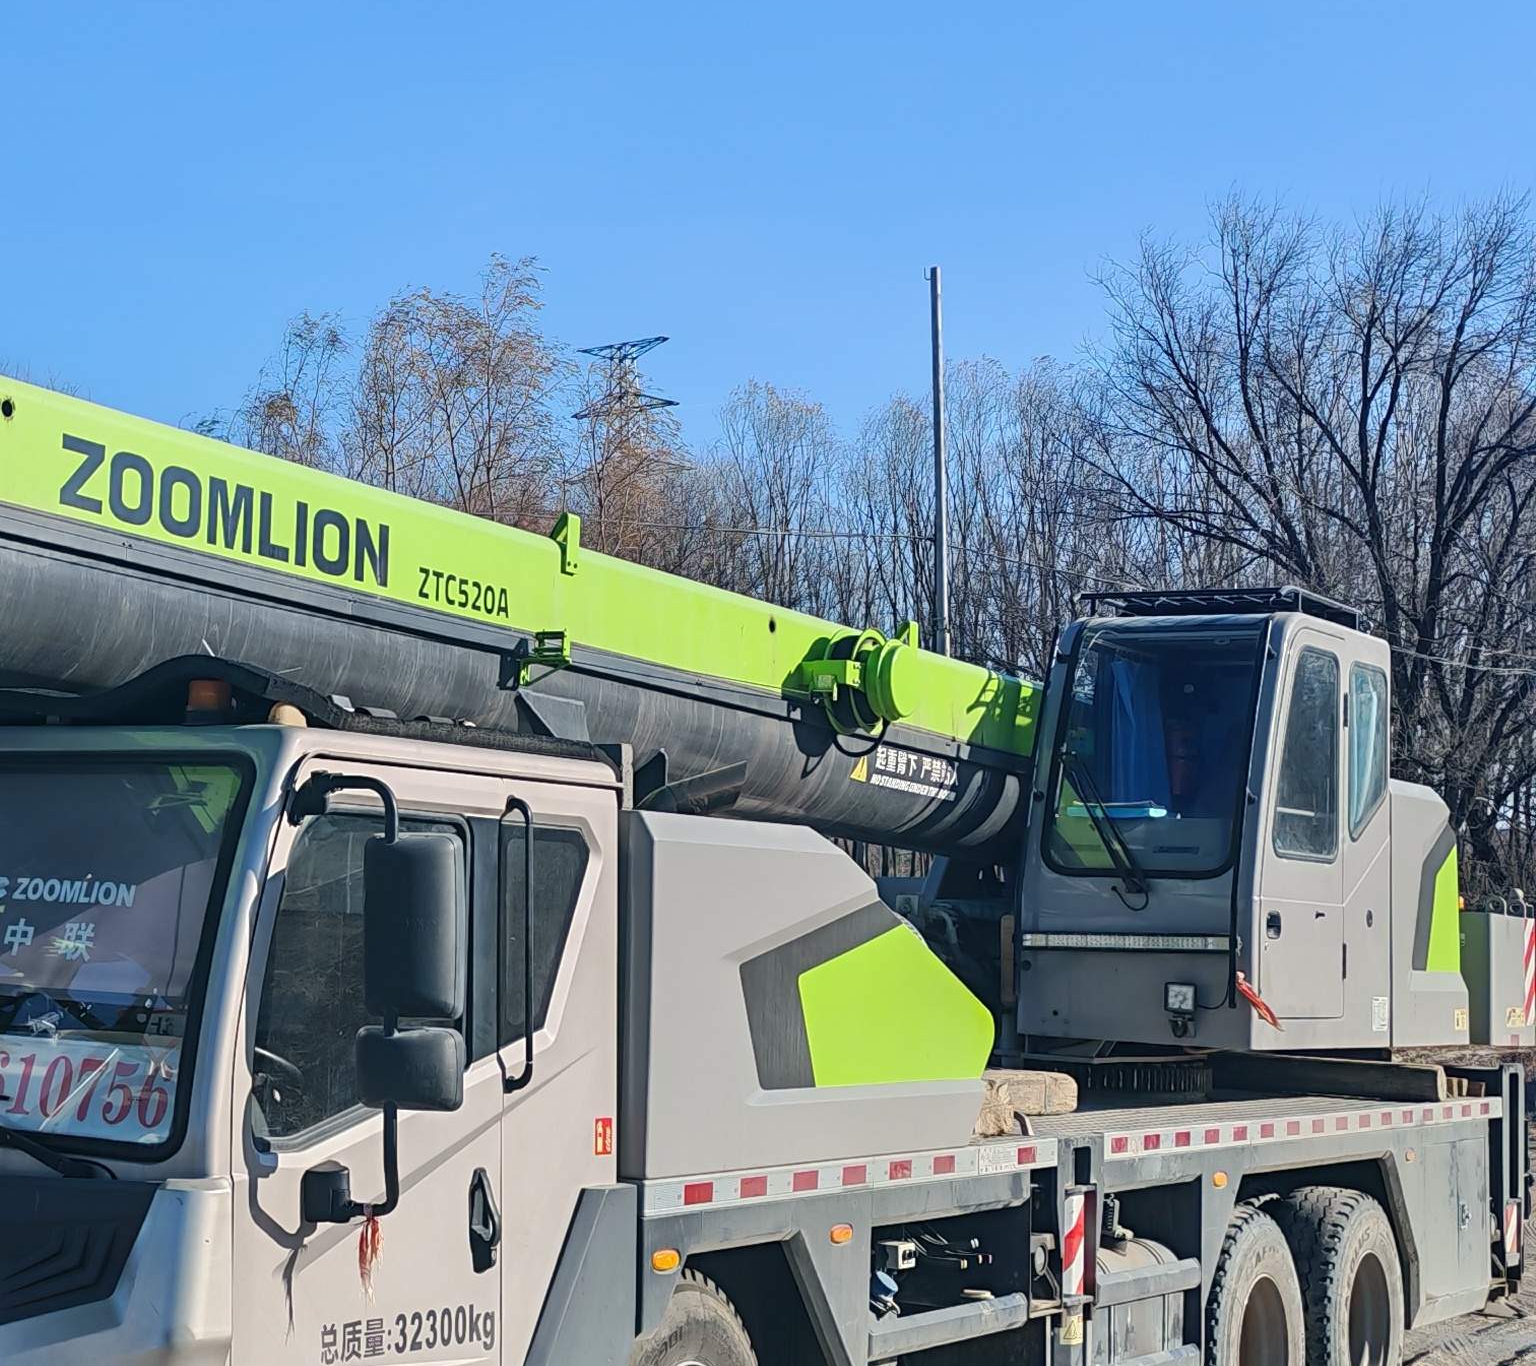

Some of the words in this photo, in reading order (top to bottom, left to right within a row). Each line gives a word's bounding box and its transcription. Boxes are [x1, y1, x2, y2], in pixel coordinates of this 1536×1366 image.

[59, 433, 390, 587] ZOOMLION
[417, 567, 510, 619] ZTC520A
[870, 773, 880, 785] NO
[879, 775, 911, 792] STANDING
[12, 877, 136, 907] ZOOMLION
[320, 1304, 495, 1365] 总质量:32300kg
